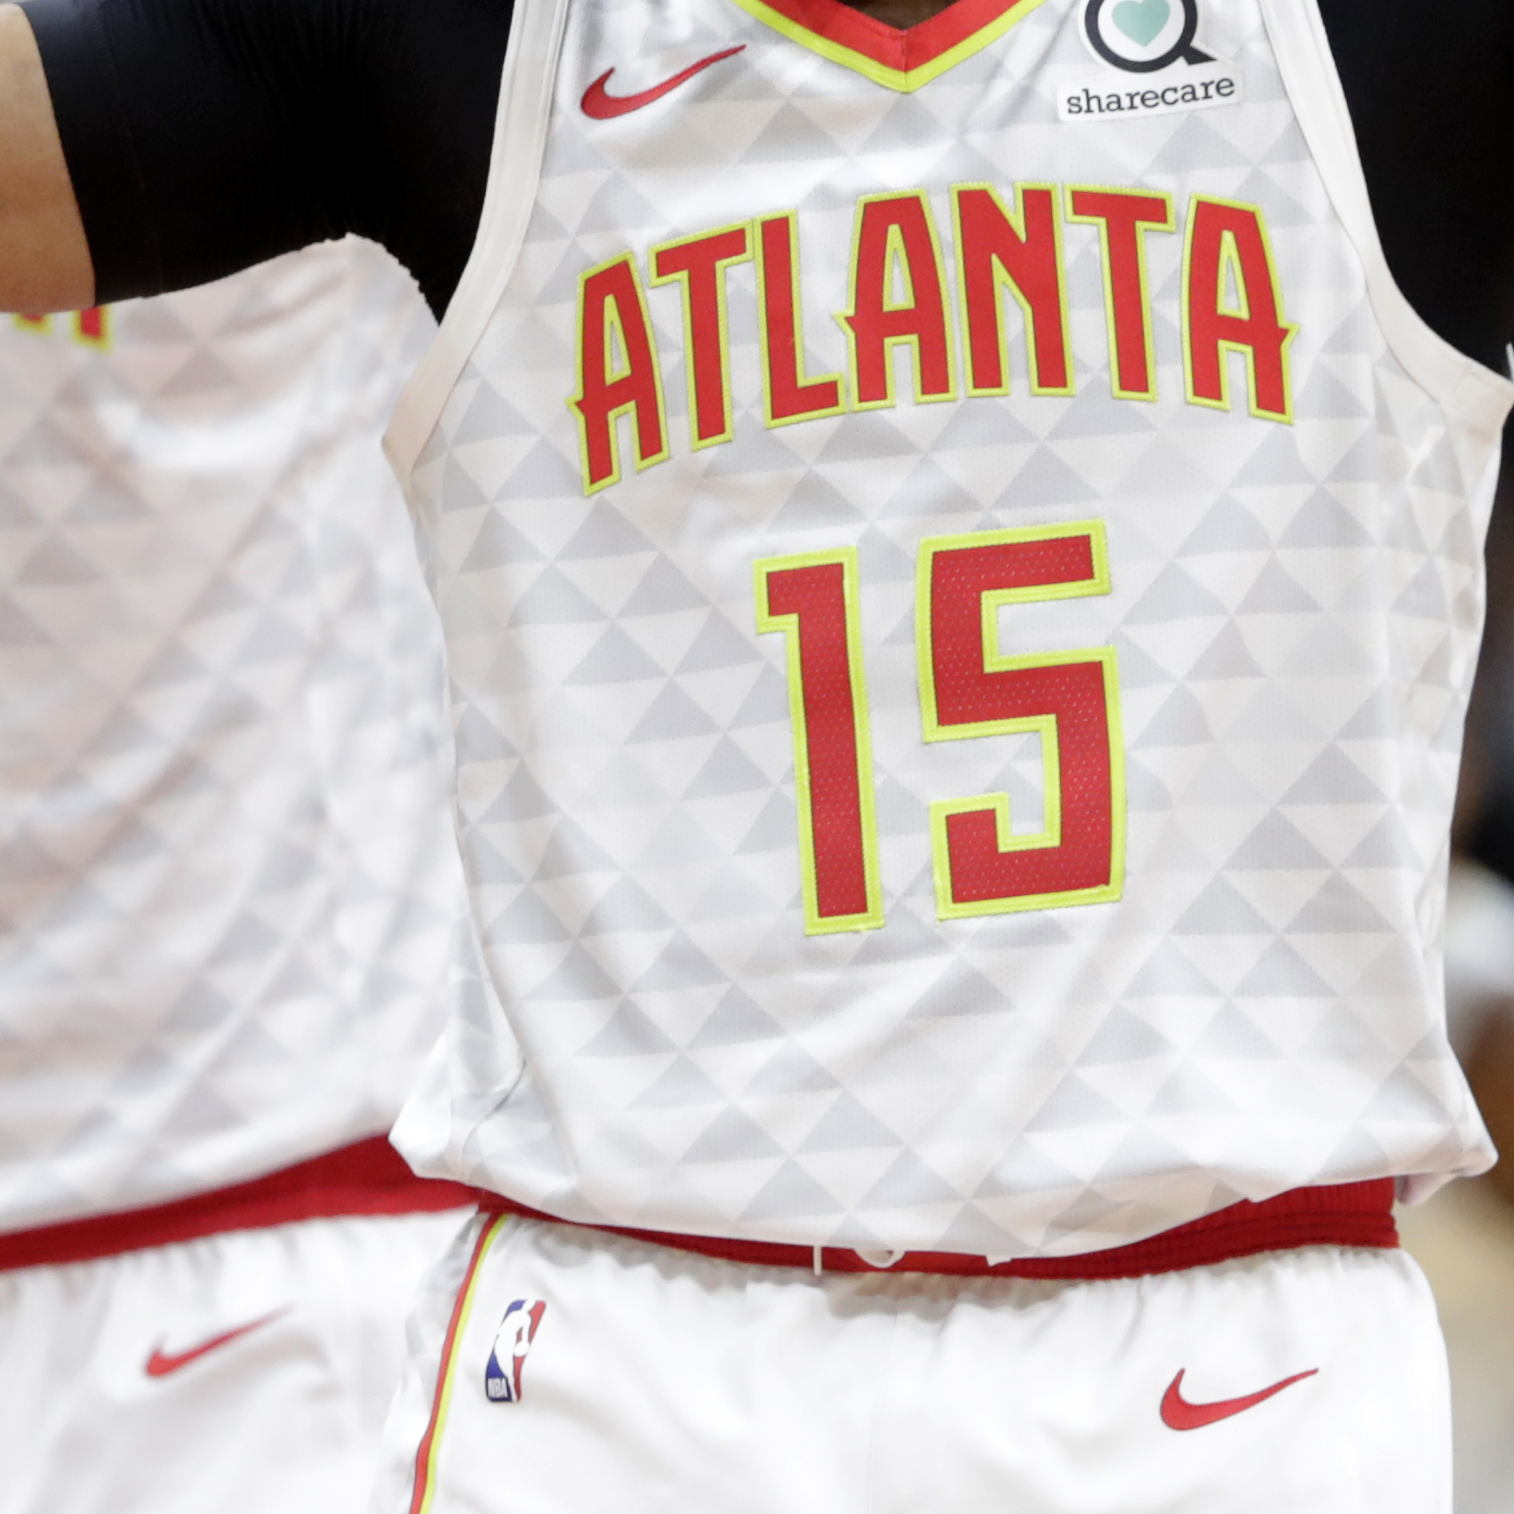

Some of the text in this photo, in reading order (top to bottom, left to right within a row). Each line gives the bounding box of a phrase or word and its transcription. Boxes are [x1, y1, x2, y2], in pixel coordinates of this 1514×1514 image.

[1066, 76, 1235, 114] sharecare
[566, 182, 1300, 496] ATLANTA
[753, 519, 1128, 936] 15
[487, 1377, 508, 1398] NBA
